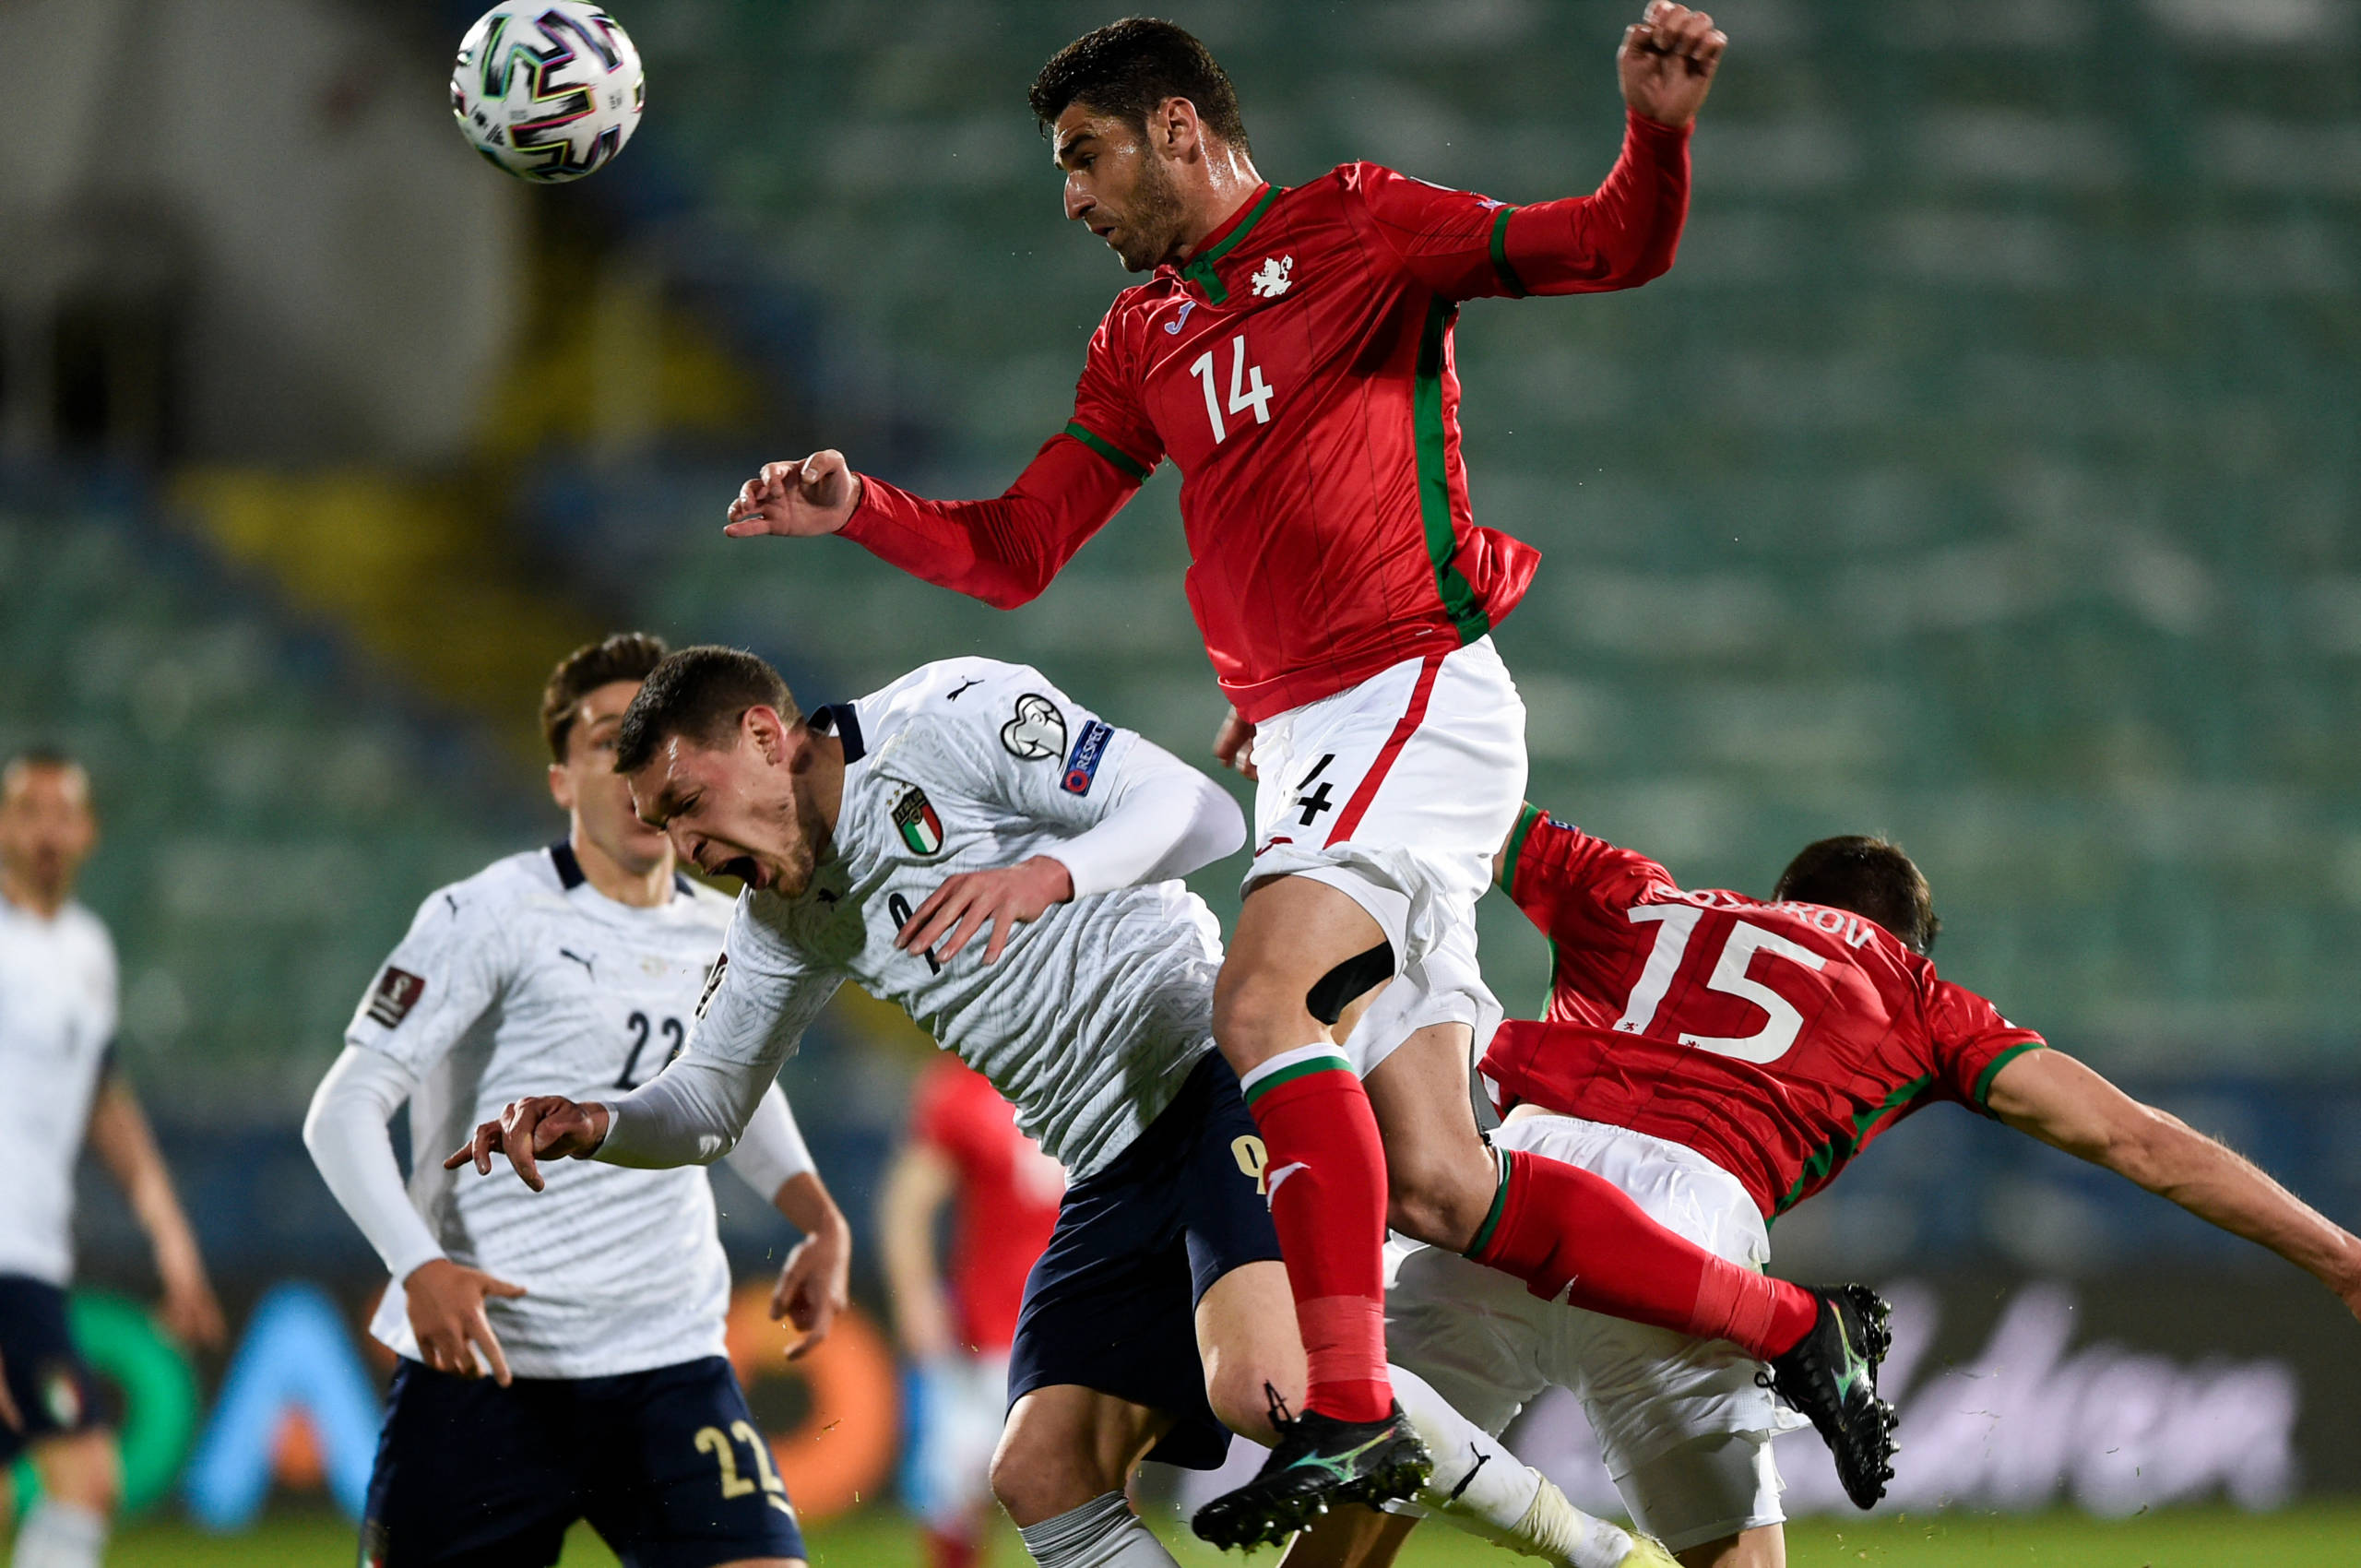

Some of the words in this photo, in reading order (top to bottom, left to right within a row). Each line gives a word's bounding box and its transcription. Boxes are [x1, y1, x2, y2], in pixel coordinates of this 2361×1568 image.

[1189, 335, 1275, 445] 14
[1611, 902, 1828, 1065] 15
[611, 1011, 685, 1091] 22
[1230, 1134, 1269, 1195] 9
[694, 1419, 785, 1501] 22
